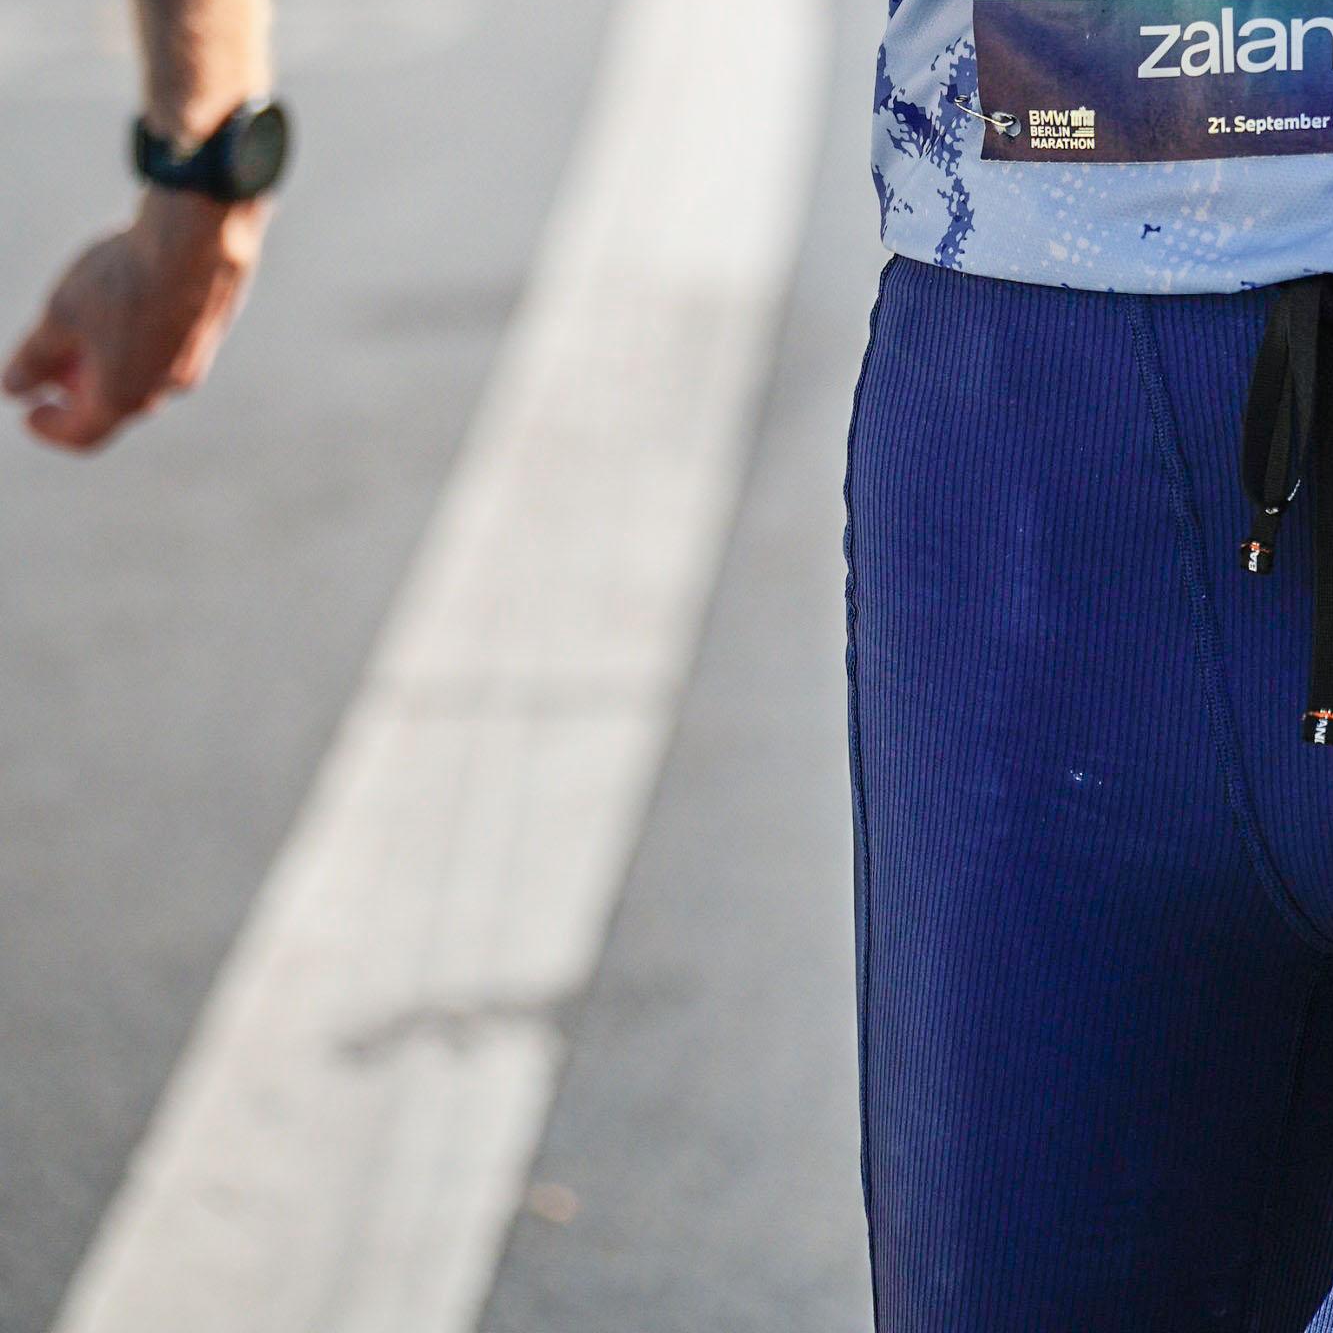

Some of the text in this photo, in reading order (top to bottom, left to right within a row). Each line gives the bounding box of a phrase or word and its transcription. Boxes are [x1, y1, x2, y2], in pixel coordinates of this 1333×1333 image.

[1029, 109, 1069, 126] BMW
[1208, 116, 1231, 134] 21.
[1234, 113, 1331, 135] September
[1030, 126, 1070, 137] BERLIN
[1031, 138, 1095, 149] MARATHON
